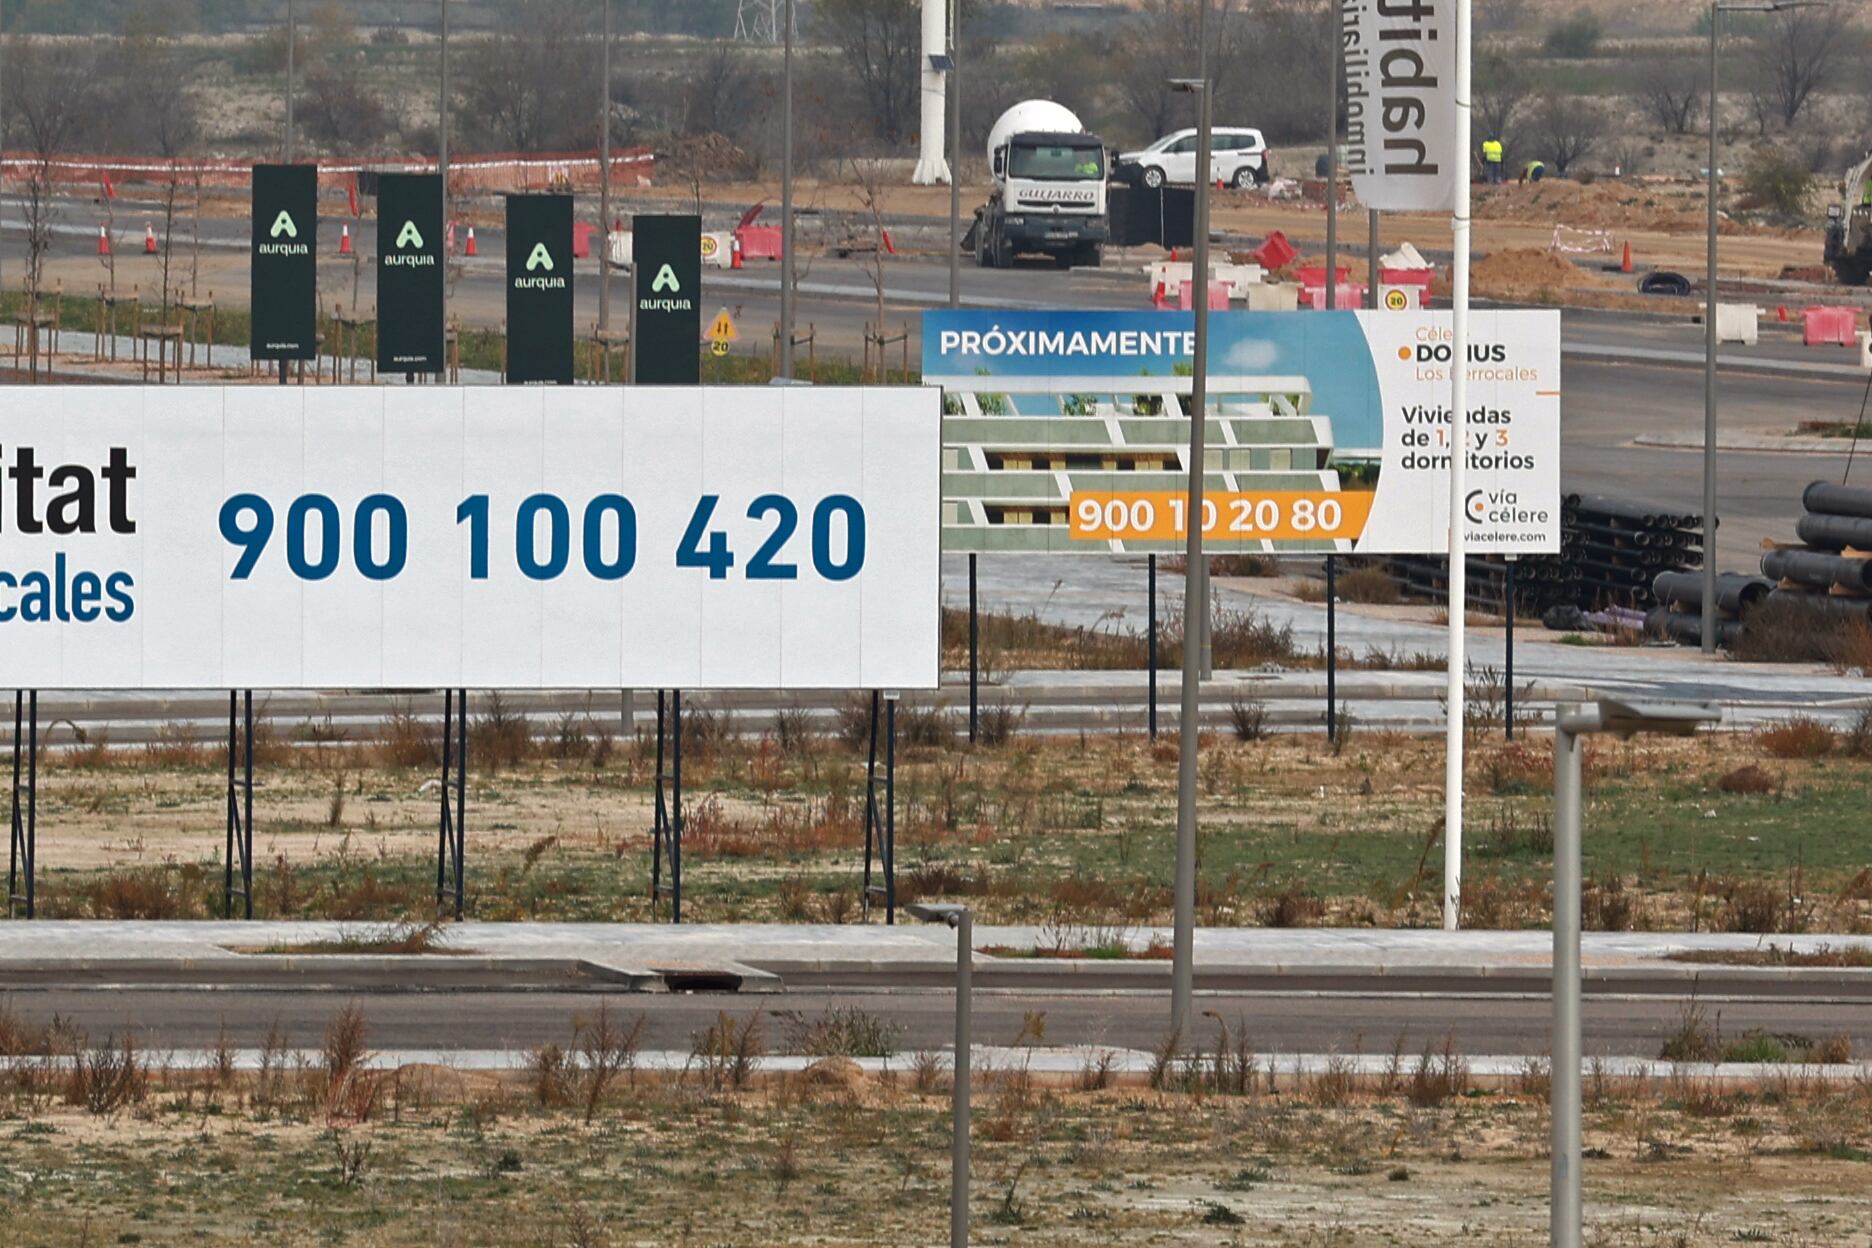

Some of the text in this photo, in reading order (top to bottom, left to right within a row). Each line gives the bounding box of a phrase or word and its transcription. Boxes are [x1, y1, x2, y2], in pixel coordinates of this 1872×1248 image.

[259, 243, 309, 257] aurquia
[384, 254, 435, 268] aurquia
[514, 276, 566, 291] aurquia
[639, 298, 692, 312] aurquia
[1390, 296, 1403, 306] 20
[712, 340, 729, 352] 20
[939, 324, 1196, 357] PRÓXIMAMENTE
[1416, 344, 1506, 362] DOIUS
[1416, 366, 1444, 382] Los
[1401, 428, 1430, 447] de
[1474, 431, 1489, 451] y
[1496, 429, 1509, 447] 3
[1488, 488, 1518, 505] vía
[1077, 498, 1343, 533] 900 10 20 80
[1488, 506, 1549, 524] célere
[218, 492, 867, 581] 900 100 420
